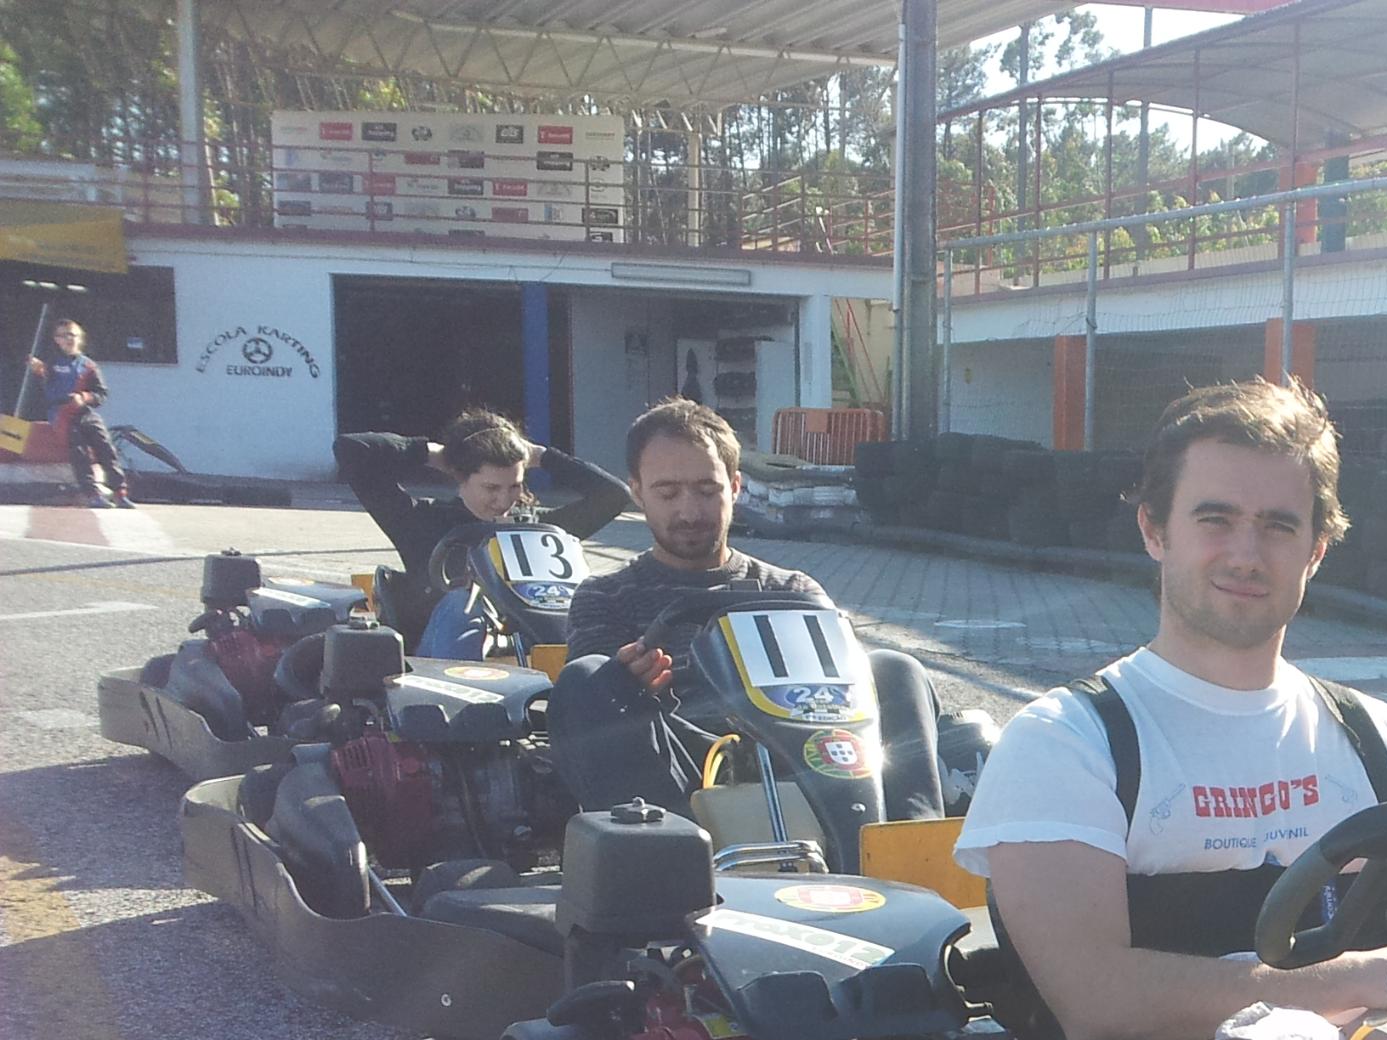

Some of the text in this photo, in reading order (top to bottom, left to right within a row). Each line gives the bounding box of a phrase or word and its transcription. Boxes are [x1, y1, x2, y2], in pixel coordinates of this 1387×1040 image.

[196, 325, 319, 379] ESCOLA KARTING
[226, 364, 293, 378] EUROINDY
[510, 533, 574, 580] 13
[752, 615, 840, 678] 11
[793, 686, 834, 704] 24
[1192, 774, 1319, 818] GRINGO'S
